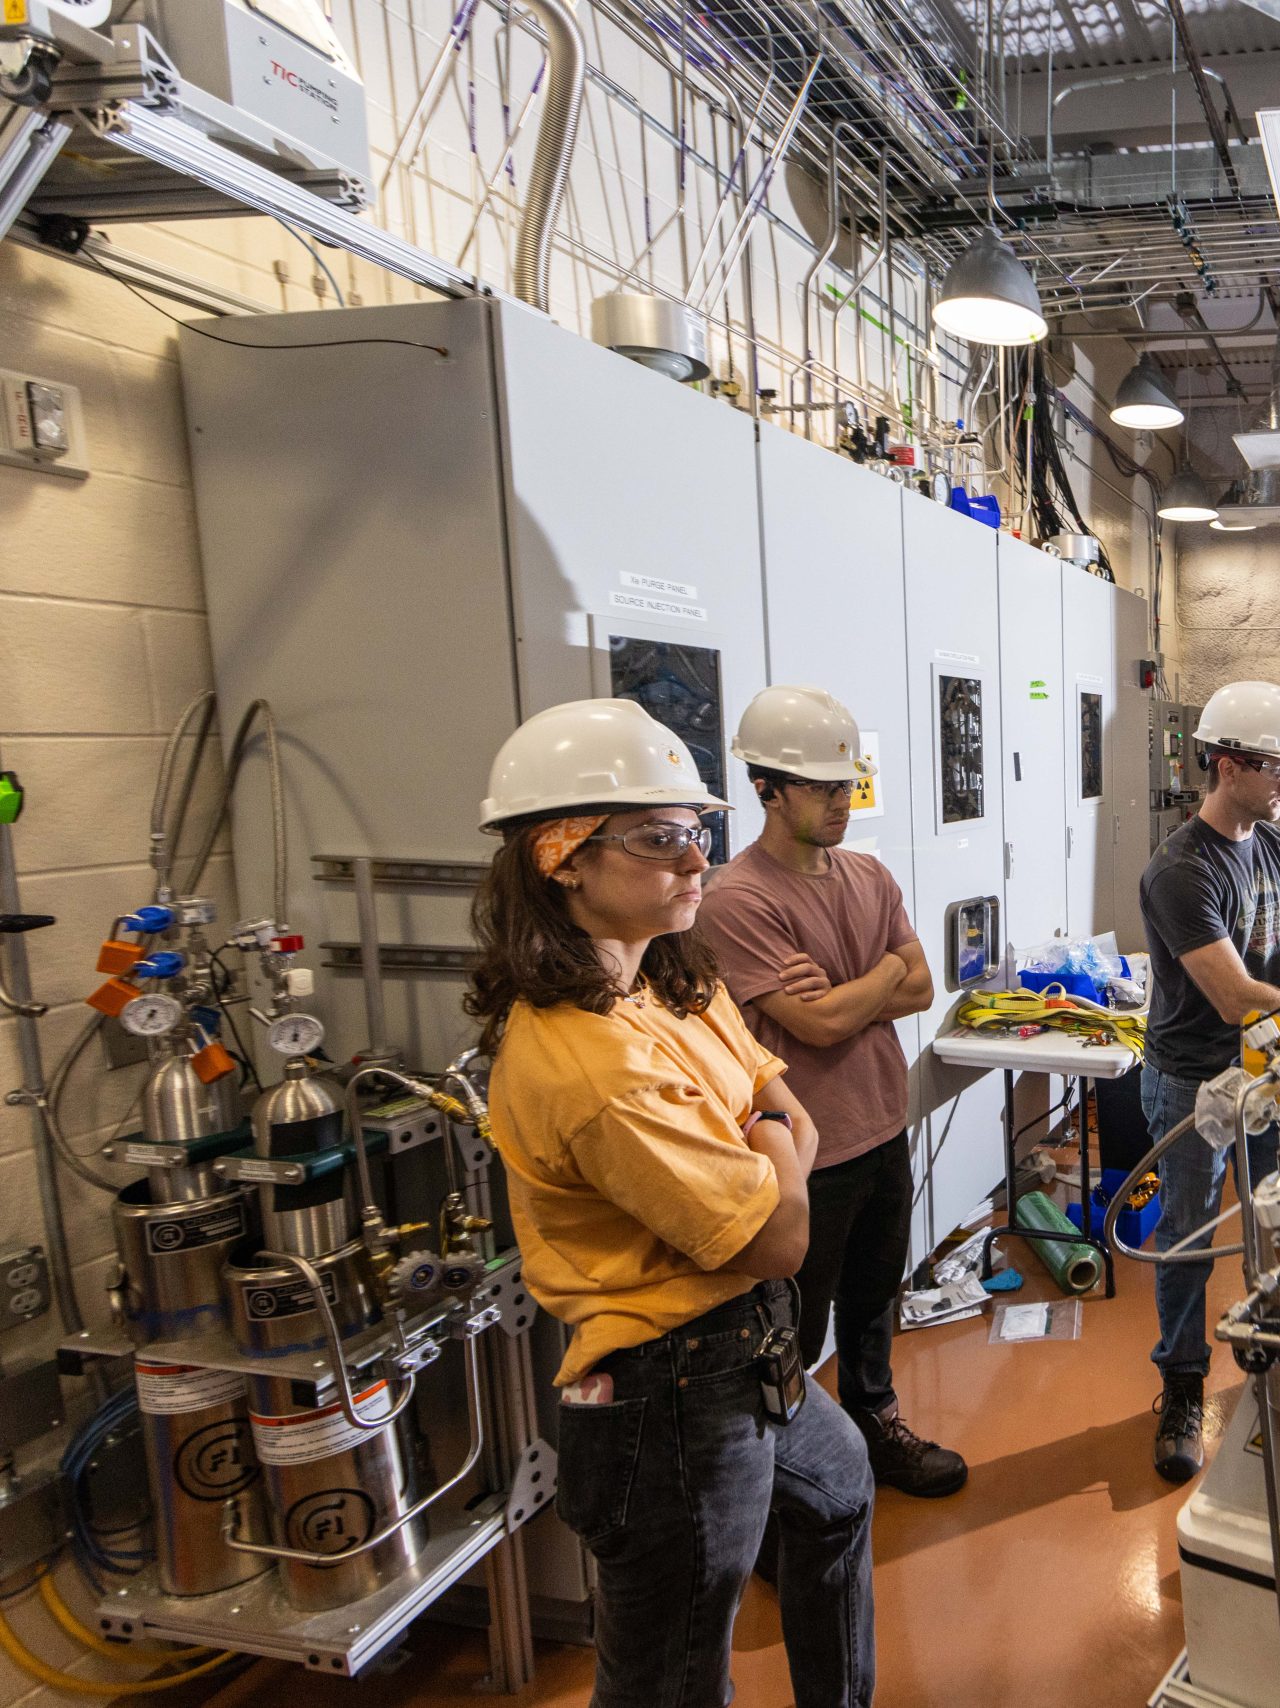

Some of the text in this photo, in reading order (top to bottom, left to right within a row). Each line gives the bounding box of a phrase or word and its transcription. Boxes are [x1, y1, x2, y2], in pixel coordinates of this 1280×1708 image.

[270, 60, 298, 88] TIC
[641, 578, 666, 591] PURGE
[666, 583, 690, 596] PANEL
[613, 594, 703, 618] SOURCE INJECTION PANEL
